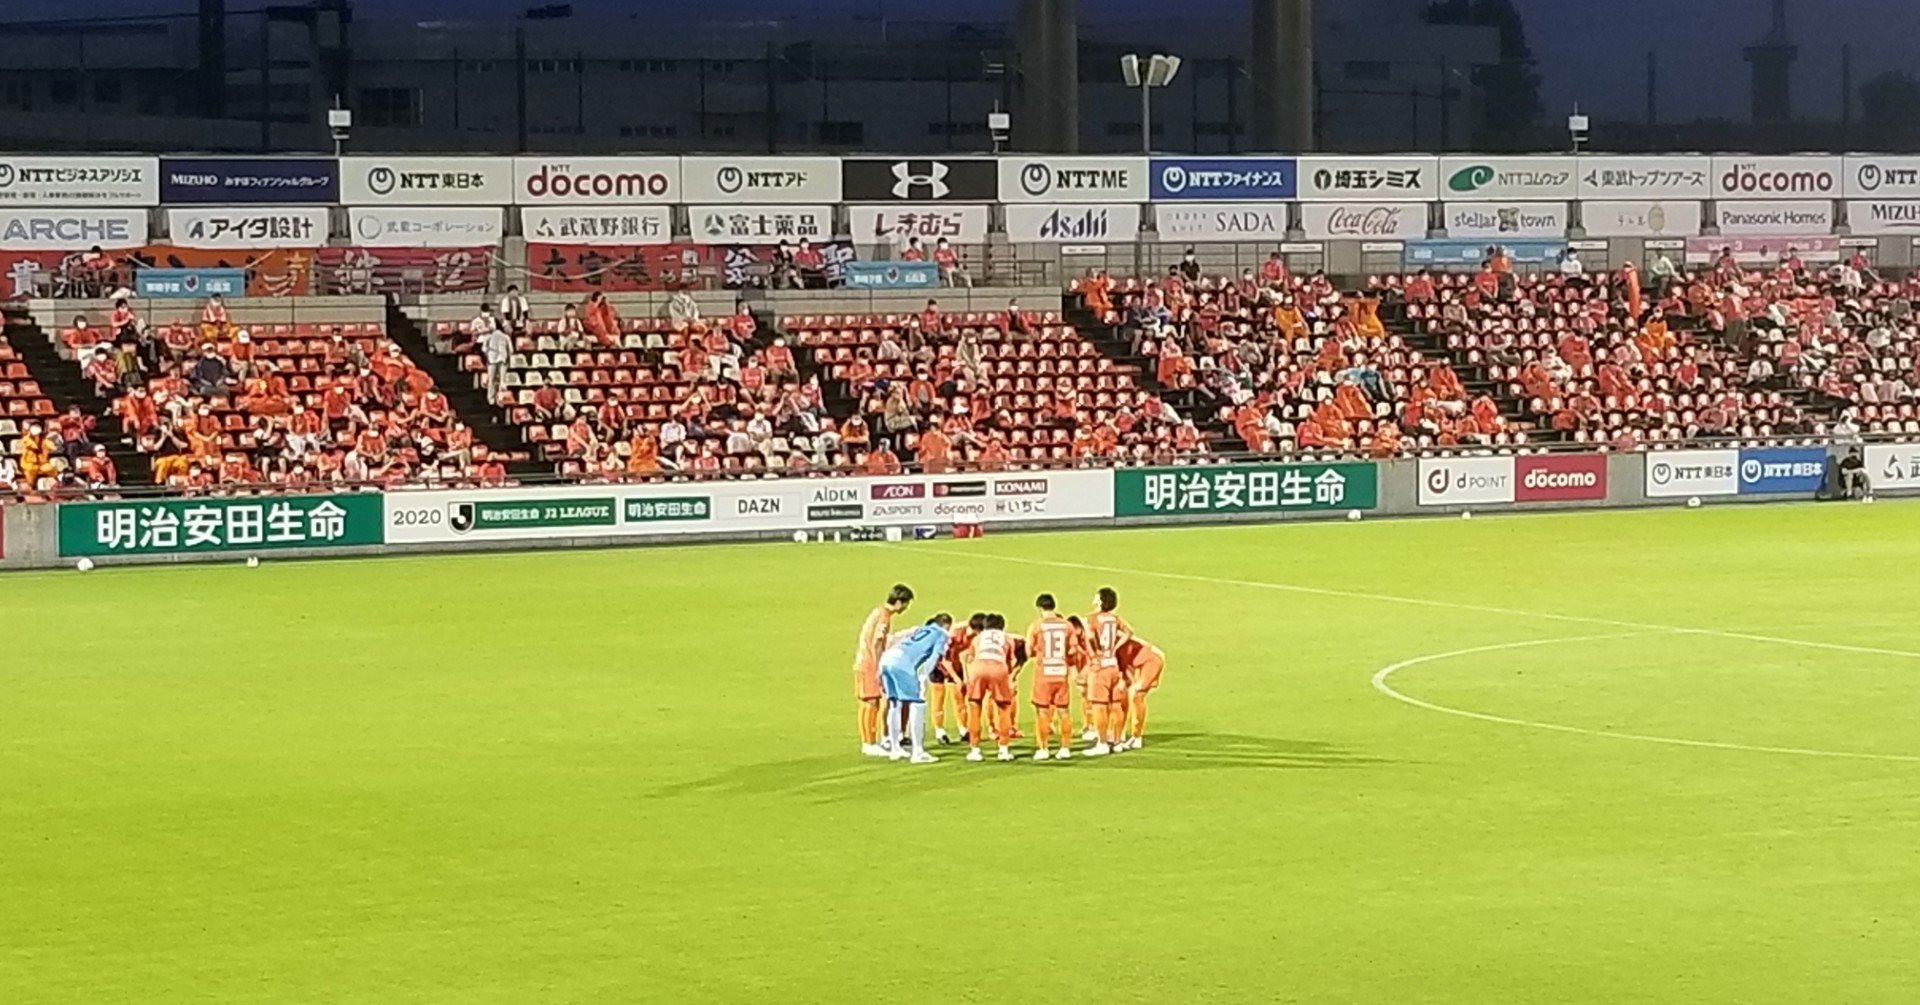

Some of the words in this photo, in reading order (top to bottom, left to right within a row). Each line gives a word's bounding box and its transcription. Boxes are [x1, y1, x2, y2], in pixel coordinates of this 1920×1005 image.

[171, 174, 218, 186] MIZUHO
[400, 173, 484, 188] NTT東日本
[527, 165, 668, 196] docomo
[747, 172, 808, 188] NTTアド
[1189, 171, 1283, 187] NTTファイナンス
[1335, 169, 1422, 189] 埼玉シミズ
[1499, 172, 1569, 186] NTTコムウェア
[1722, 164, 1833, 192] docomo
[728, 214, 818, 236] 富士薬品
[1040, 208, 1107, 238] Asahi
[1216, 211, 1275, 232] SADA
[1454, 211, 1498, 229] stellar
[1520, 212, 1556, 228] town
[1722, 211, 1781, 226] Panasonic
[1783, 209, 1826, 225] Homes
[3, 219, 129, 241] ARCHE
[209, 217, 314, 239] アイダ設計
[560, 217, 660, 237] 武蔵野銀行
[1470, 475, 1507, 488] POINT
[1524, 469, 1597, 489] docomo
[1675, 466, 1733, 480] NTT東日本
[996, 482, 1046, 493] KONAMI
[1144, 468, 1346, 510] 明治安田生命
[560, 506, 609, 518] LEAGUE
[628, 501, 706, 518] 明治安田生命
[738, 499, 781, 514] DAZN
[934, 503, 985, 515] docomo
[97, 500, 347, 549] 明治安田生命
[393, 509, 442, 526] 2020
[1045, 630, 1066, 658] 13
